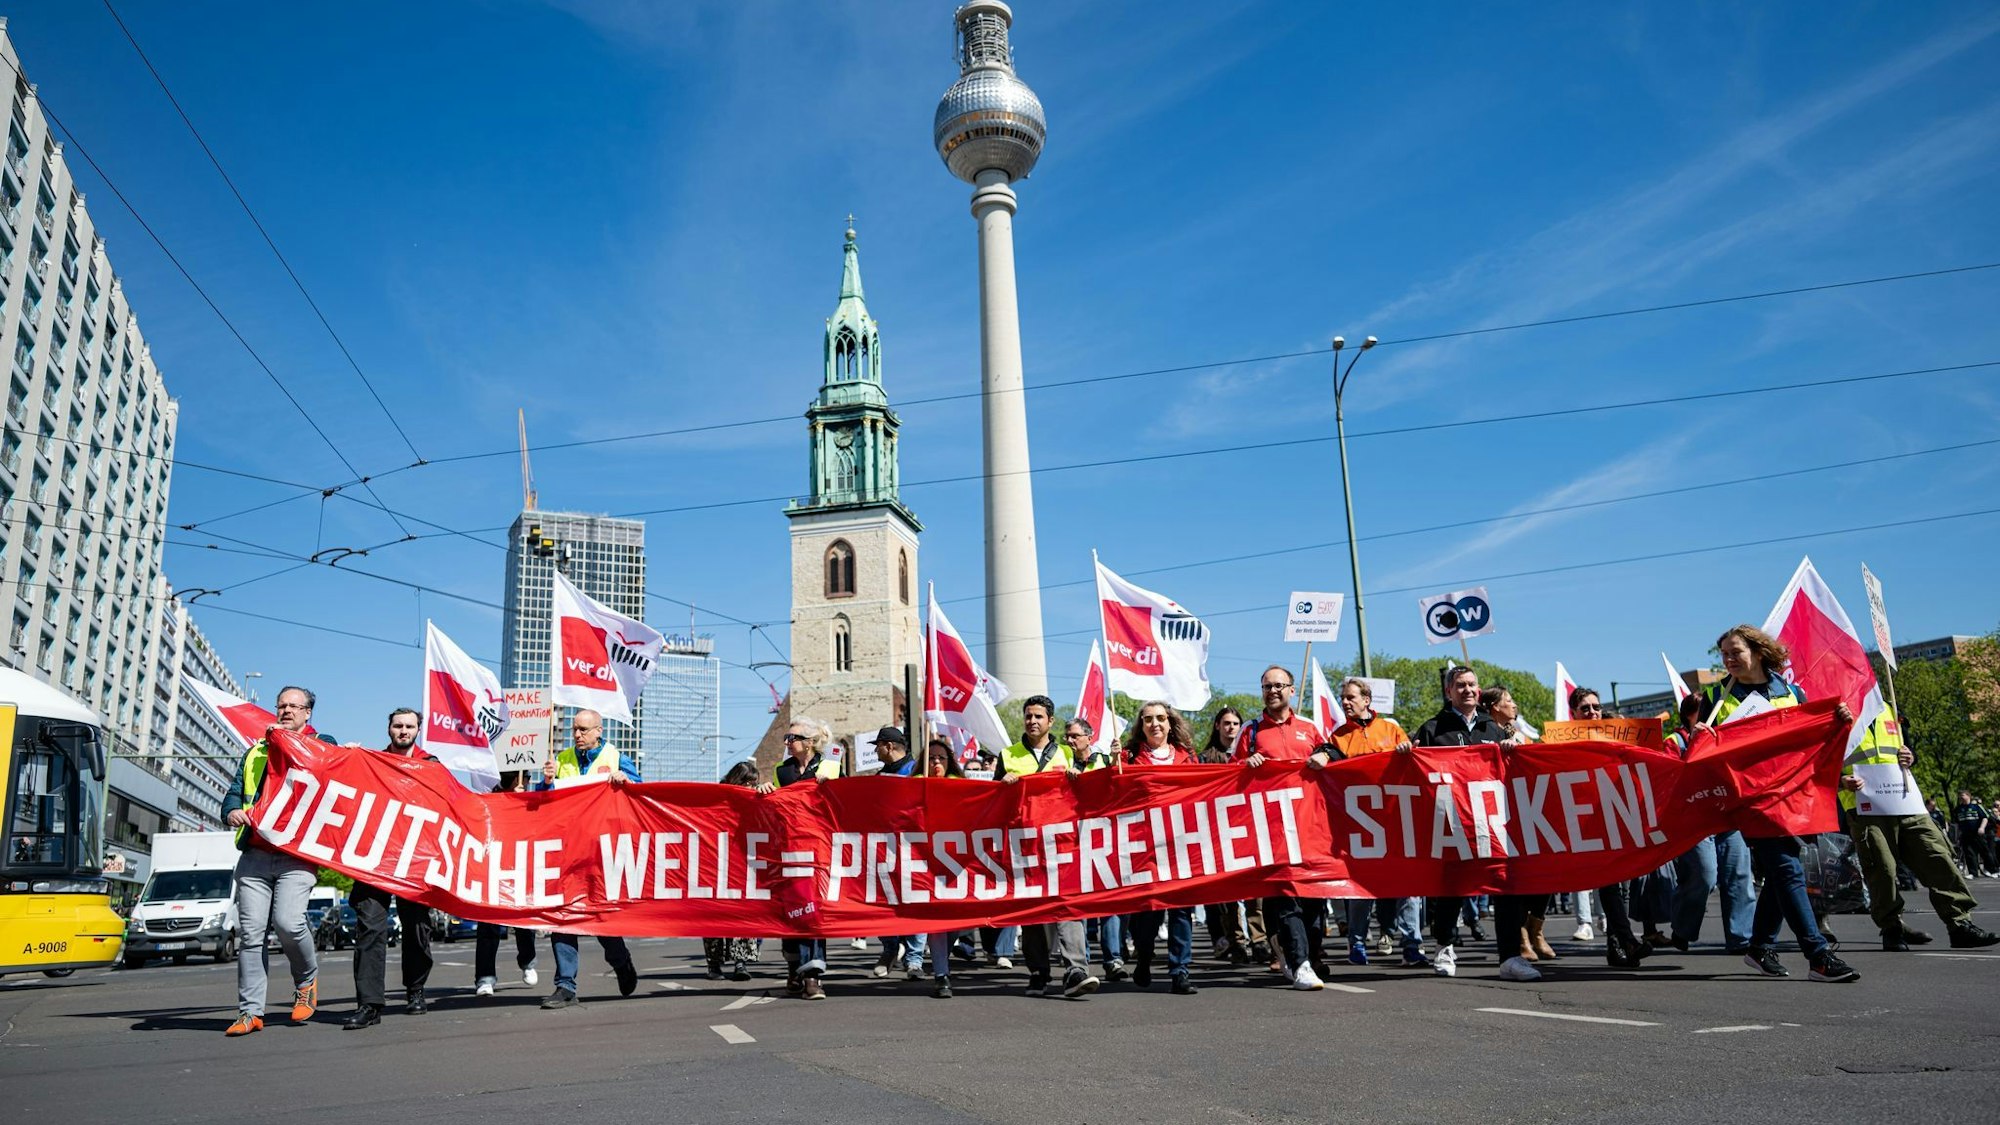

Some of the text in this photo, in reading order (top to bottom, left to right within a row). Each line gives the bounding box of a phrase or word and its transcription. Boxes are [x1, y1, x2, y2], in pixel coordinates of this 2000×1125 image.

[1106, 640, 1157, 666] ver.di
[505, 691, 541, 705] MAKE
[508, 708, 551, 719] FORMATION
[432, 711, 486, 740] ver.di
[511, 734, 538, 747] NOT
[506, 751, 535, 765] WAR
[257, 768, 564, 907] DEUTSCHE
[600, 832, 772, 901] WELLE
[828, 787, 1304, 906] PRESSEFREIHEIT
[1344, 762, 1667, 861] STÄRKEN!
[23, 941, 67, 954] A-9008
